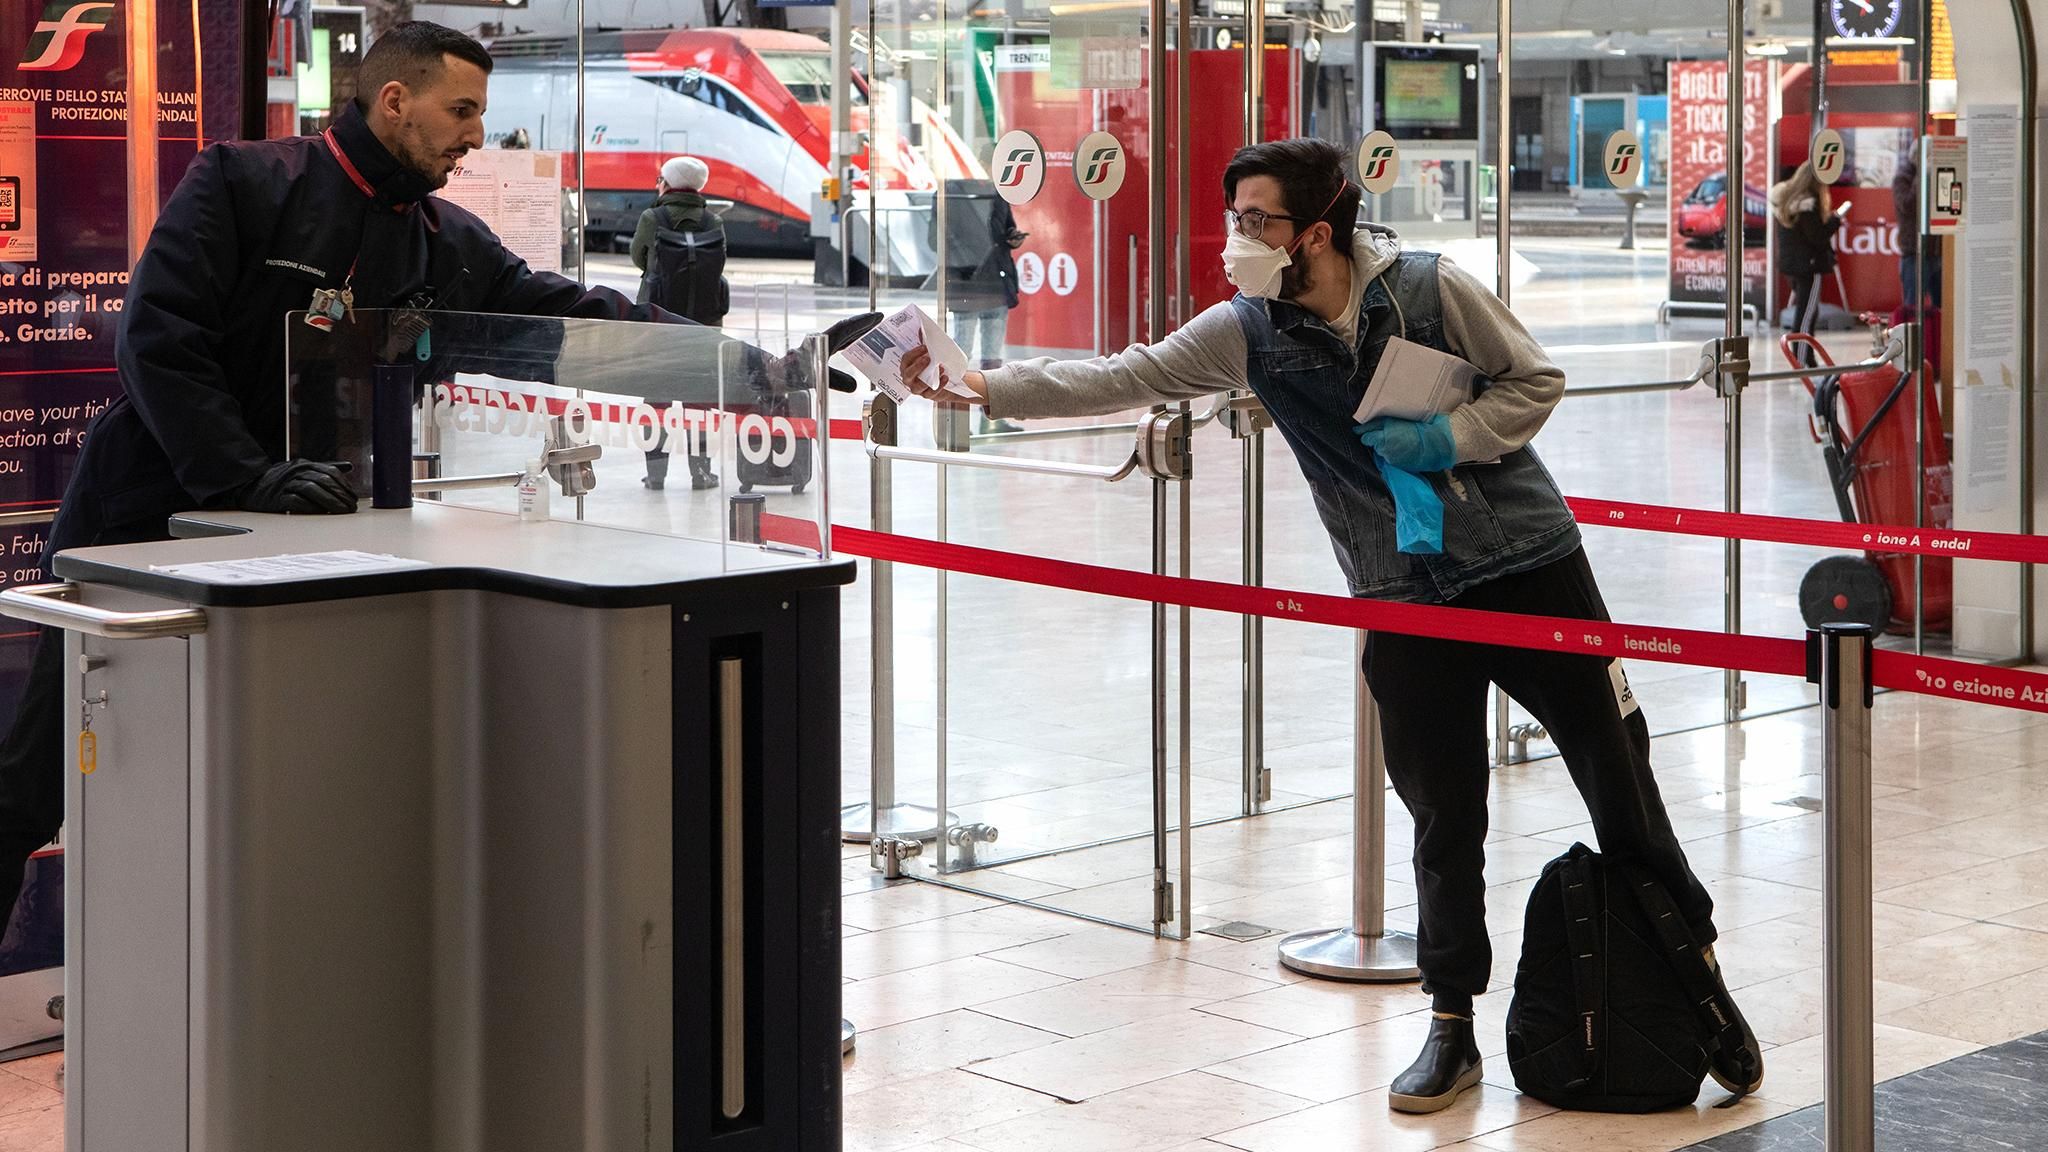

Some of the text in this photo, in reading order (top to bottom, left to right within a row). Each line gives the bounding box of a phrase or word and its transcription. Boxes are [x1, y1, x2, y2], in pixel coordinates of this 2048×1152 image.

[56, 90, 98, 103] DELLO
[101, 91, 127, 103] STAT
[1683, 104, 1756, 133] TICKS
[22, 267, 41, 286] di
[44, 299, 80, 318] per
[85, 293, 97, 313] il
[17, 322, 93, 342] Grazie.
[40, 406, 81, 426] your
[52, 427, 72, 446] at
